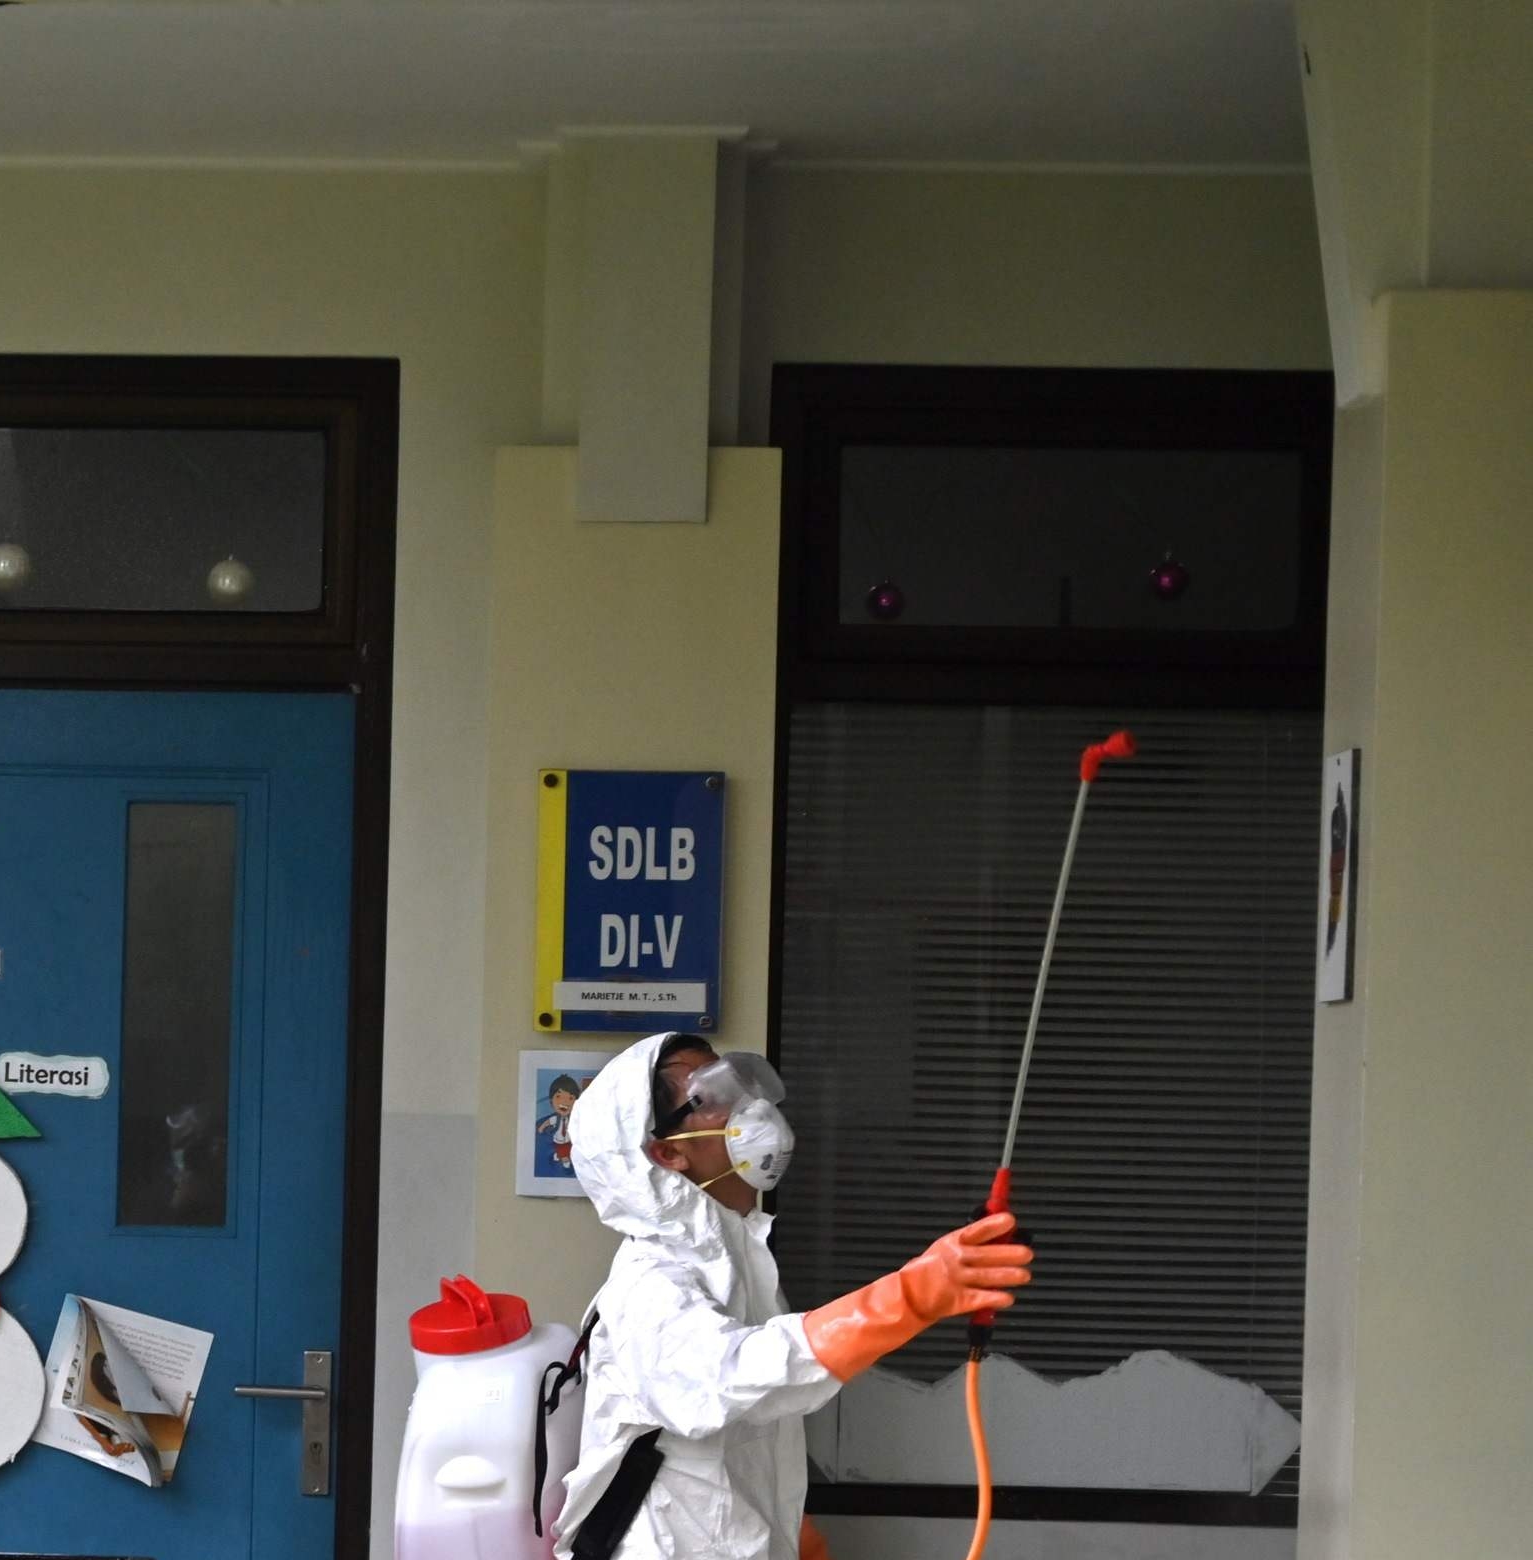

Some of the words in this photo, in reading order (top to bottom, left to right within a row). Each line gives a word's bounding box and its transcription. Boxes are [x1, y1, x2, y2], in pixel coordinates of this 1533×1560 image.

[588, 825, 696, 881] SDLB
[599, 913, 684, 969] DI-V
[581, 991, 625, 1001] MARIETJE
[4, 1061, 90, 1087] Literasi
